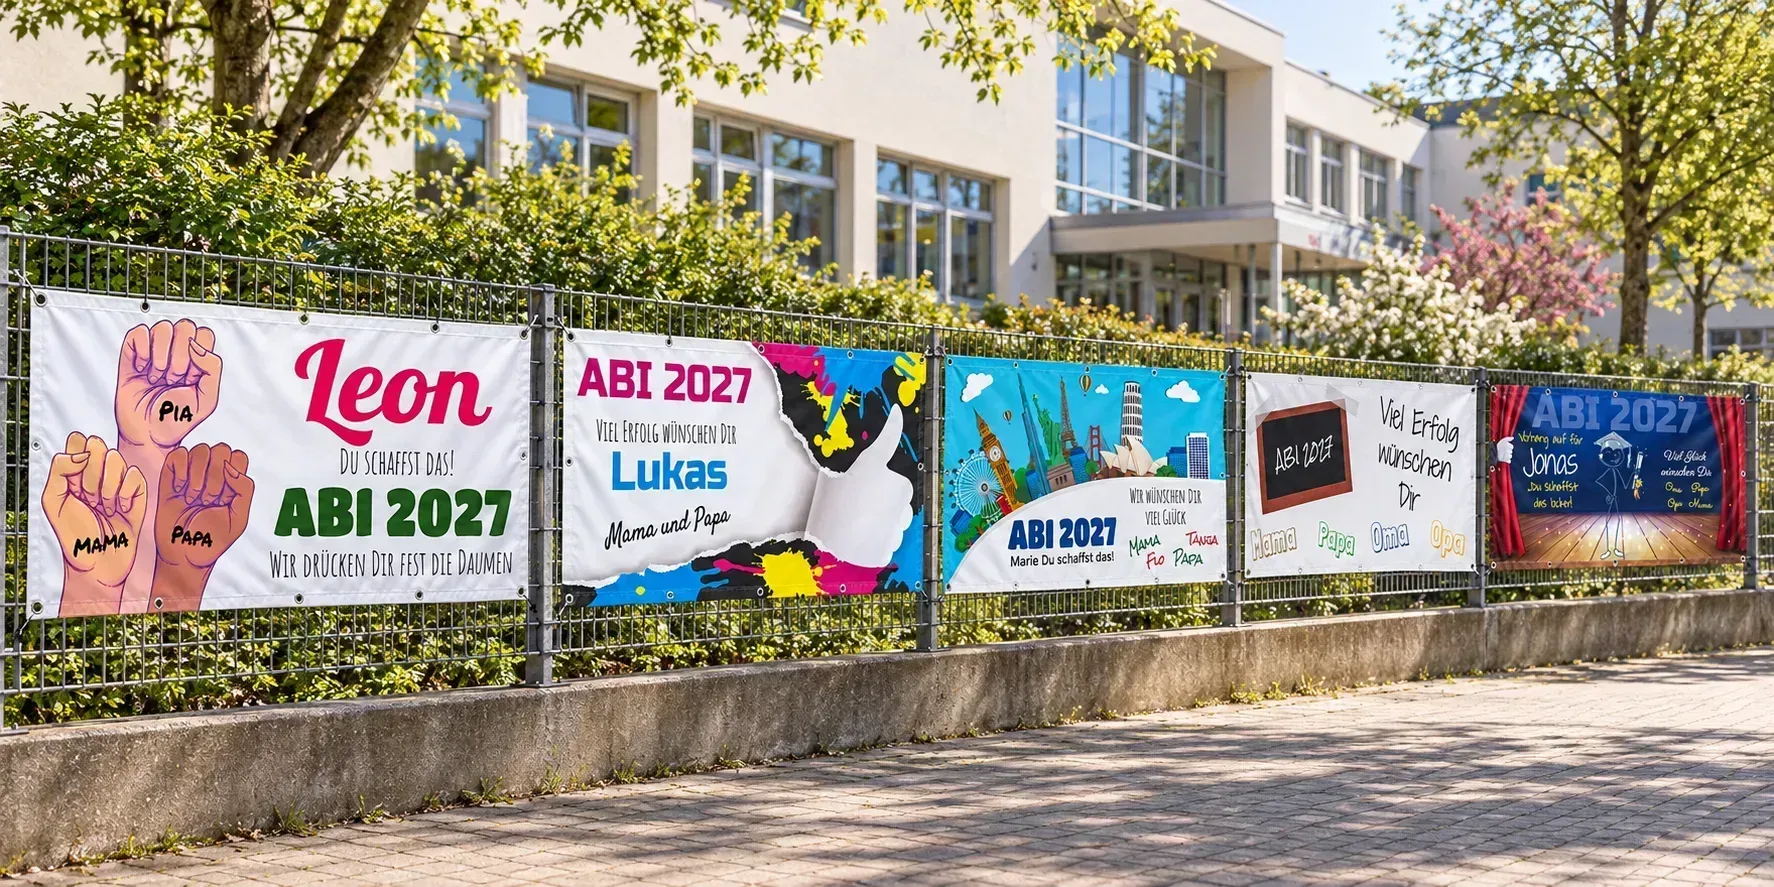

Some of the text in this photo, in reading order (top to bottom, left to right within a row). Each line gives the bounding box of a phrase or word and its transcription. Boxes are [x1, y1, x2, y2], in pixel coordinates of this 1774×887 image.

[294, 338, 492, 447] Leon
[577, 358, 752, 404] ABI 2027
[158, 400, 193, 423] PIA
[1380, 395, 1460, 453] Viel Erfolg
[1532, 394, 1698, 434] ABI 2027
[596, 418, 738, 445] VIEL ERFOLG WÜNSCHEN DIR
[340, 448, 455, 477] DU SCHAFFST DAS!
[611, 450, 728, 491] Lukas
[1274, 434, 1334, 475] ABI 2027
[1378, 442, 1452, 482] wünschen
[1522, 447, 1579, 478] Jonas
[1129, 486, 1202, 504] WIR WÜNSCHEN DIR
[1398, 480, 1421, 511] Dir
[273, 487, 512, 537] ABI 2027
[604, 505, 732, 551] Mama und Papa
[1145, 508, 1187, 526] VIEL GLÜCK
[73, 531, 129, 557] MAMA
[170, 526, 212, 548] PAPA
[1008, 516, 1117, 550] ABI 2027
[1129, 534, 1161, 558] MAMA
[1250, 526, 1298, 562] Mama
[1317, 520, 1356, 559] Papa
[1370, 521, 1410, 554] Oma
[1429, 519, 1466, 559] Opa
[269, 548, 513, 578] WIR DRÜCKEN DIR FEST DIE DAUMEN
[1010, 550, 1115, 568] Marie Du schaffst das!
[1172, 547, 1204, 567] PAPA
